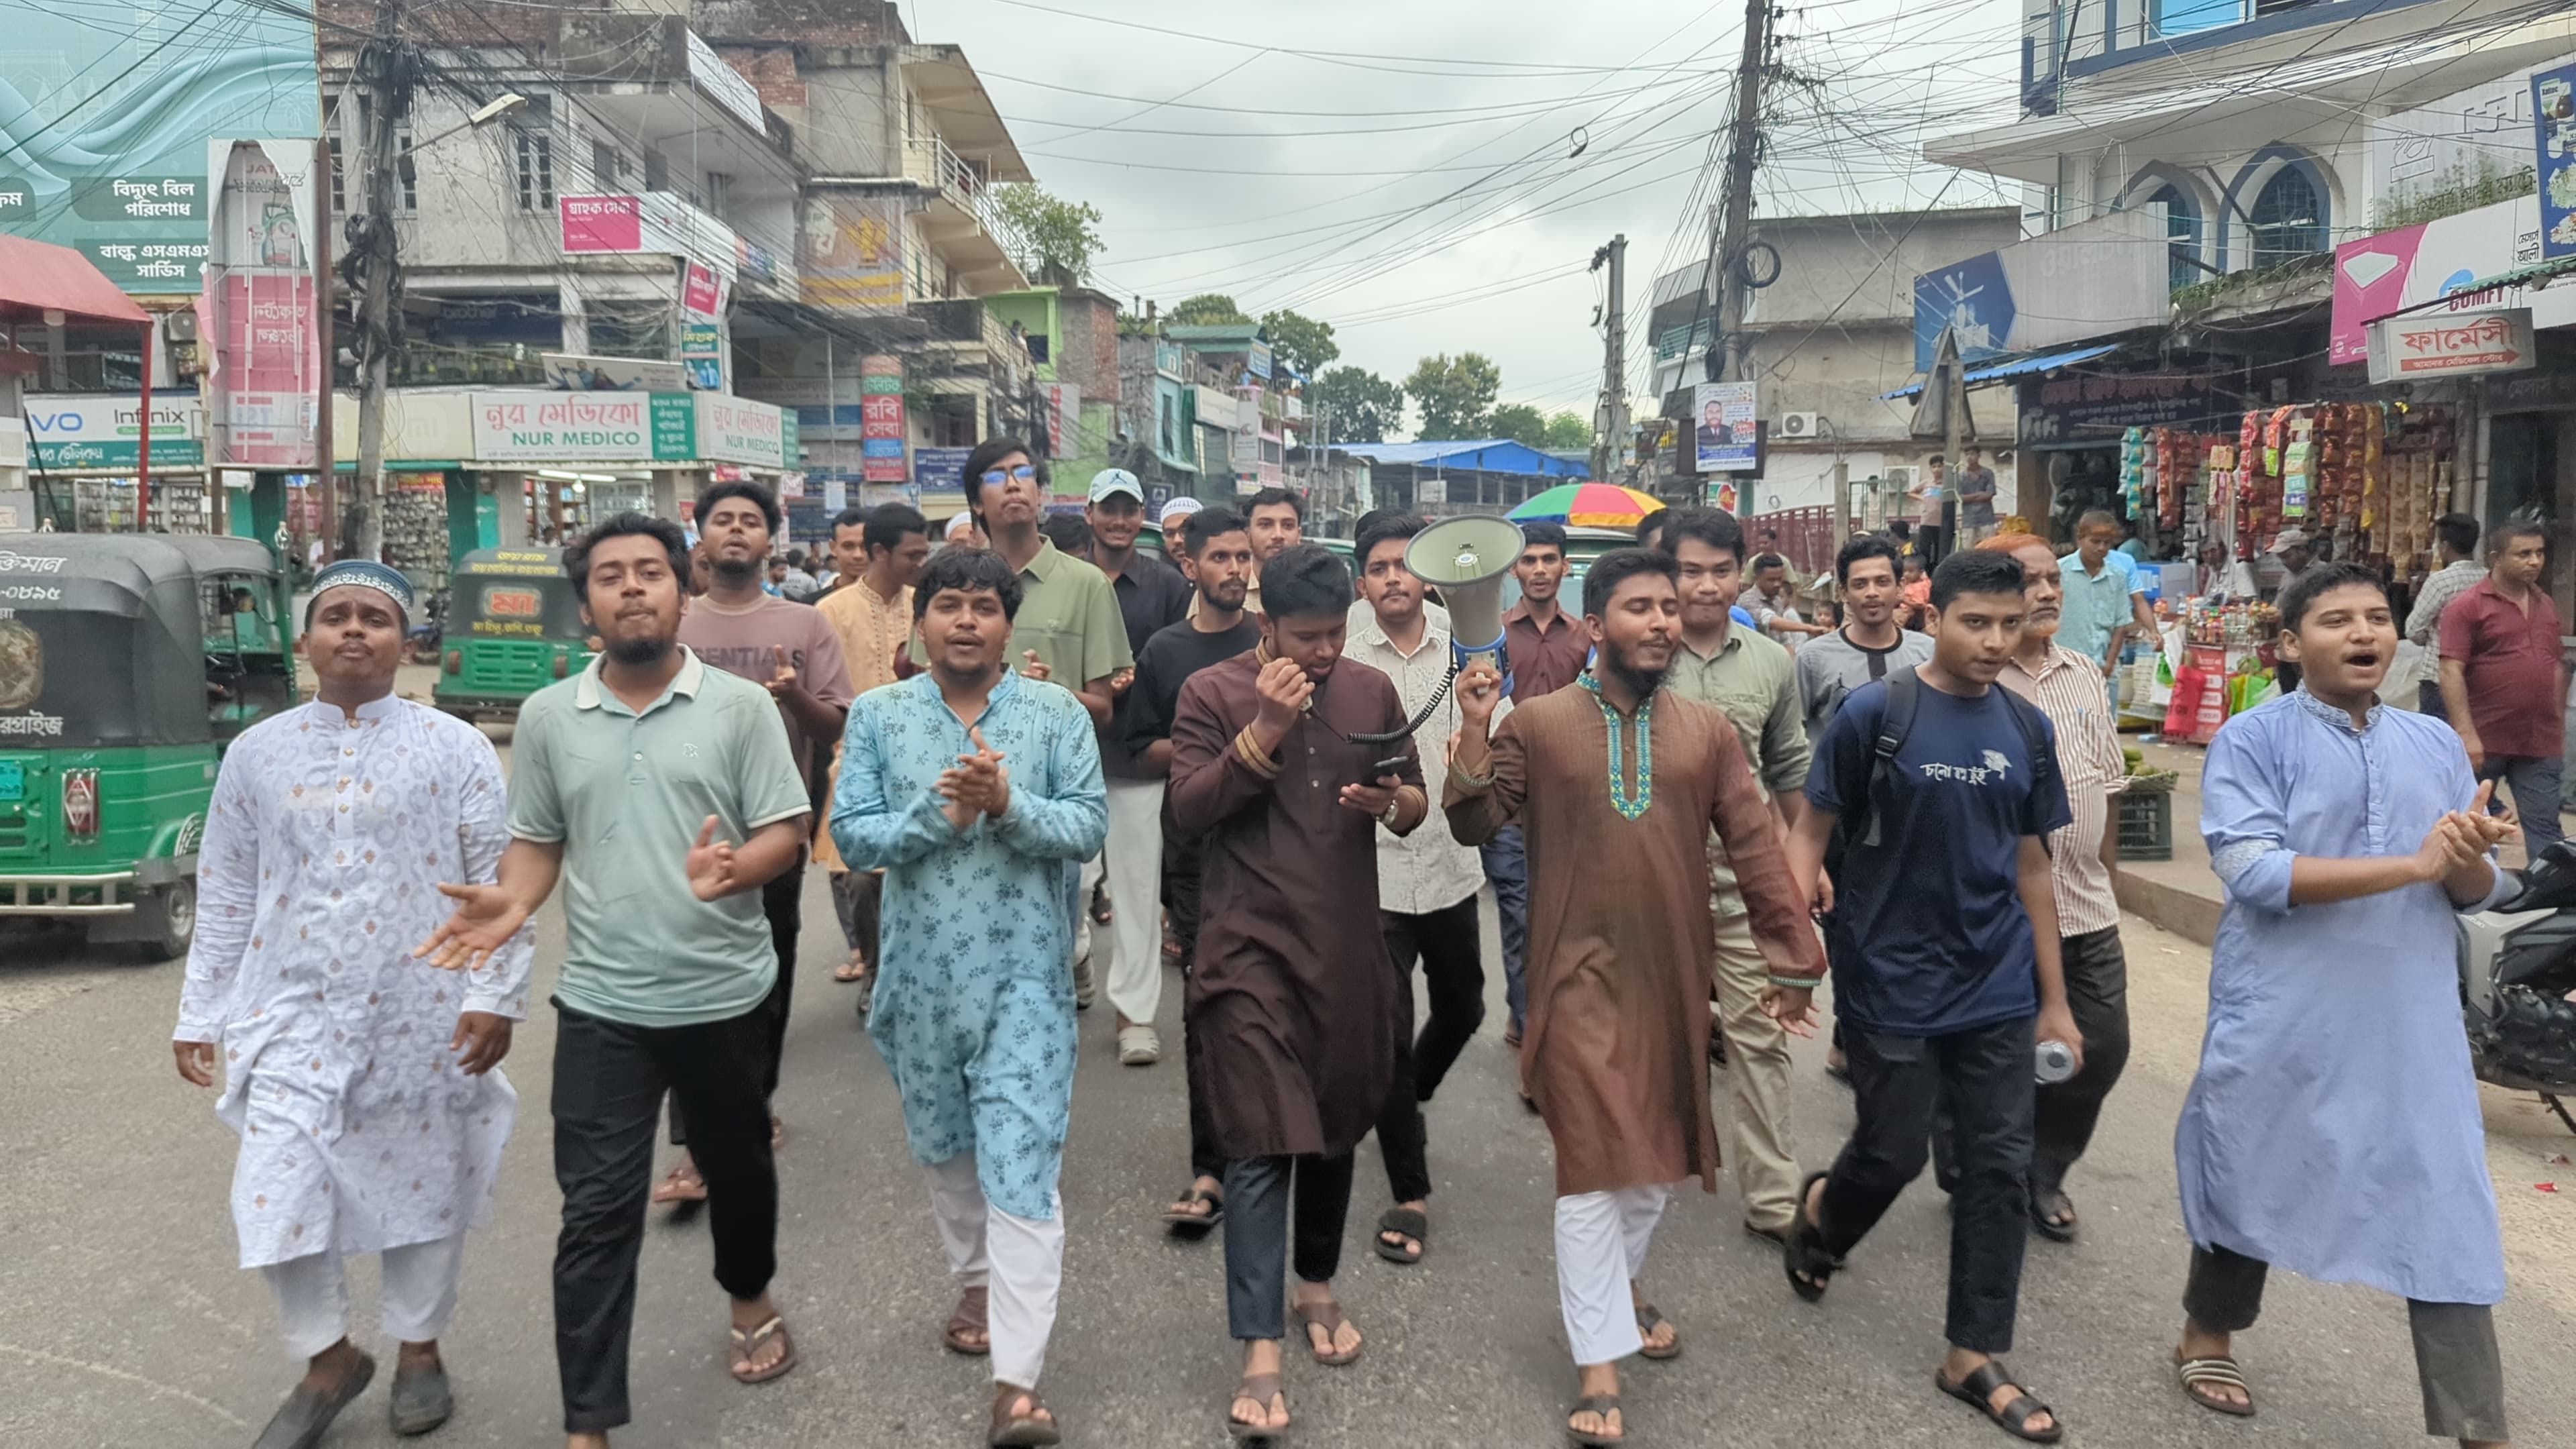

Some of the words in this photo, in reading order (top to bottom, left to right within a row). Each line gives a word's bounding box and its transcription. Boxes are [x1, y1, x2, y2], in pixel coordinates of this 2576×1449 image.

[113, 179, 158, 200] বিদ্যুৎ
[162, 179, 195, 197] বিল
[125, 199, 192, 217] পরিশোধ
[100, 244, 137, 261] বাল্ক
[136, 259, 186, 278] সার্ভিস
[2401, 316, 2516, 355] ফার্মেসী
[114, 407, 186, 424] Infnix
[539, 394, 643, 427] মেডিকো
[865, 397, 901, 420] রবি
[512, 431, 556, 446] NUR
[561, 431, 641, 447] MEDICO
[725, 434, 745, 449] NUR
[747, 438, 780, 455] MEDICO
